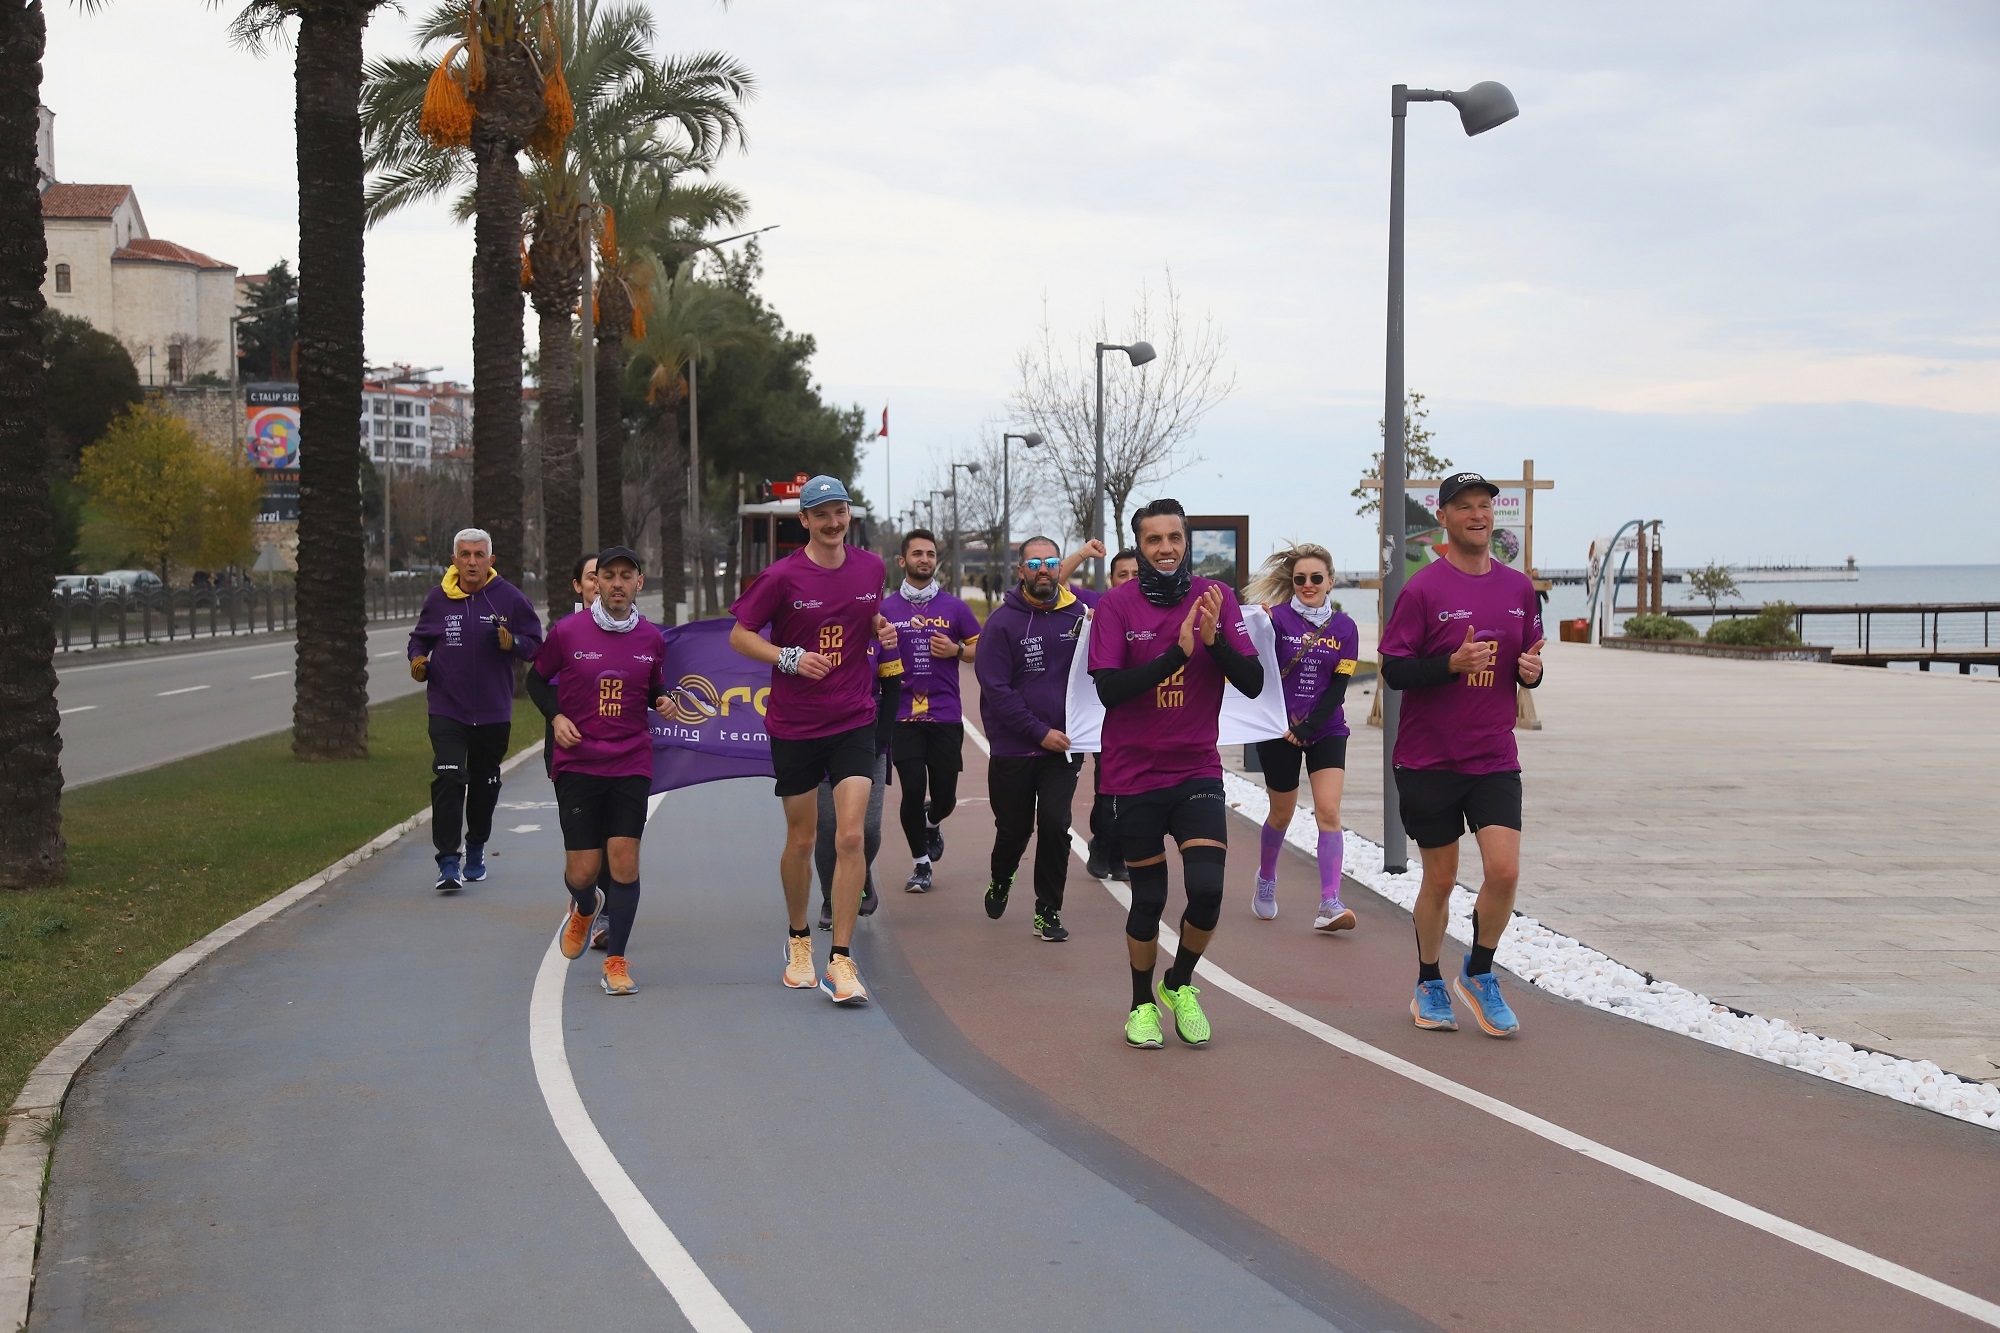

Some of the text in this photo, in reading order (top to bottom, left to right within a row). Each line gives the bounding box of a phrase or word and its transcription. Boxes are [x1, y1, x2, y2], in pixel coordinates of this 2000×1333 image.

[820, 625, 844, 649] 52
[600, 678, 623, 700] 52
[1156, 686, 1184, 708] km
[599, 698, 622, 717] km
